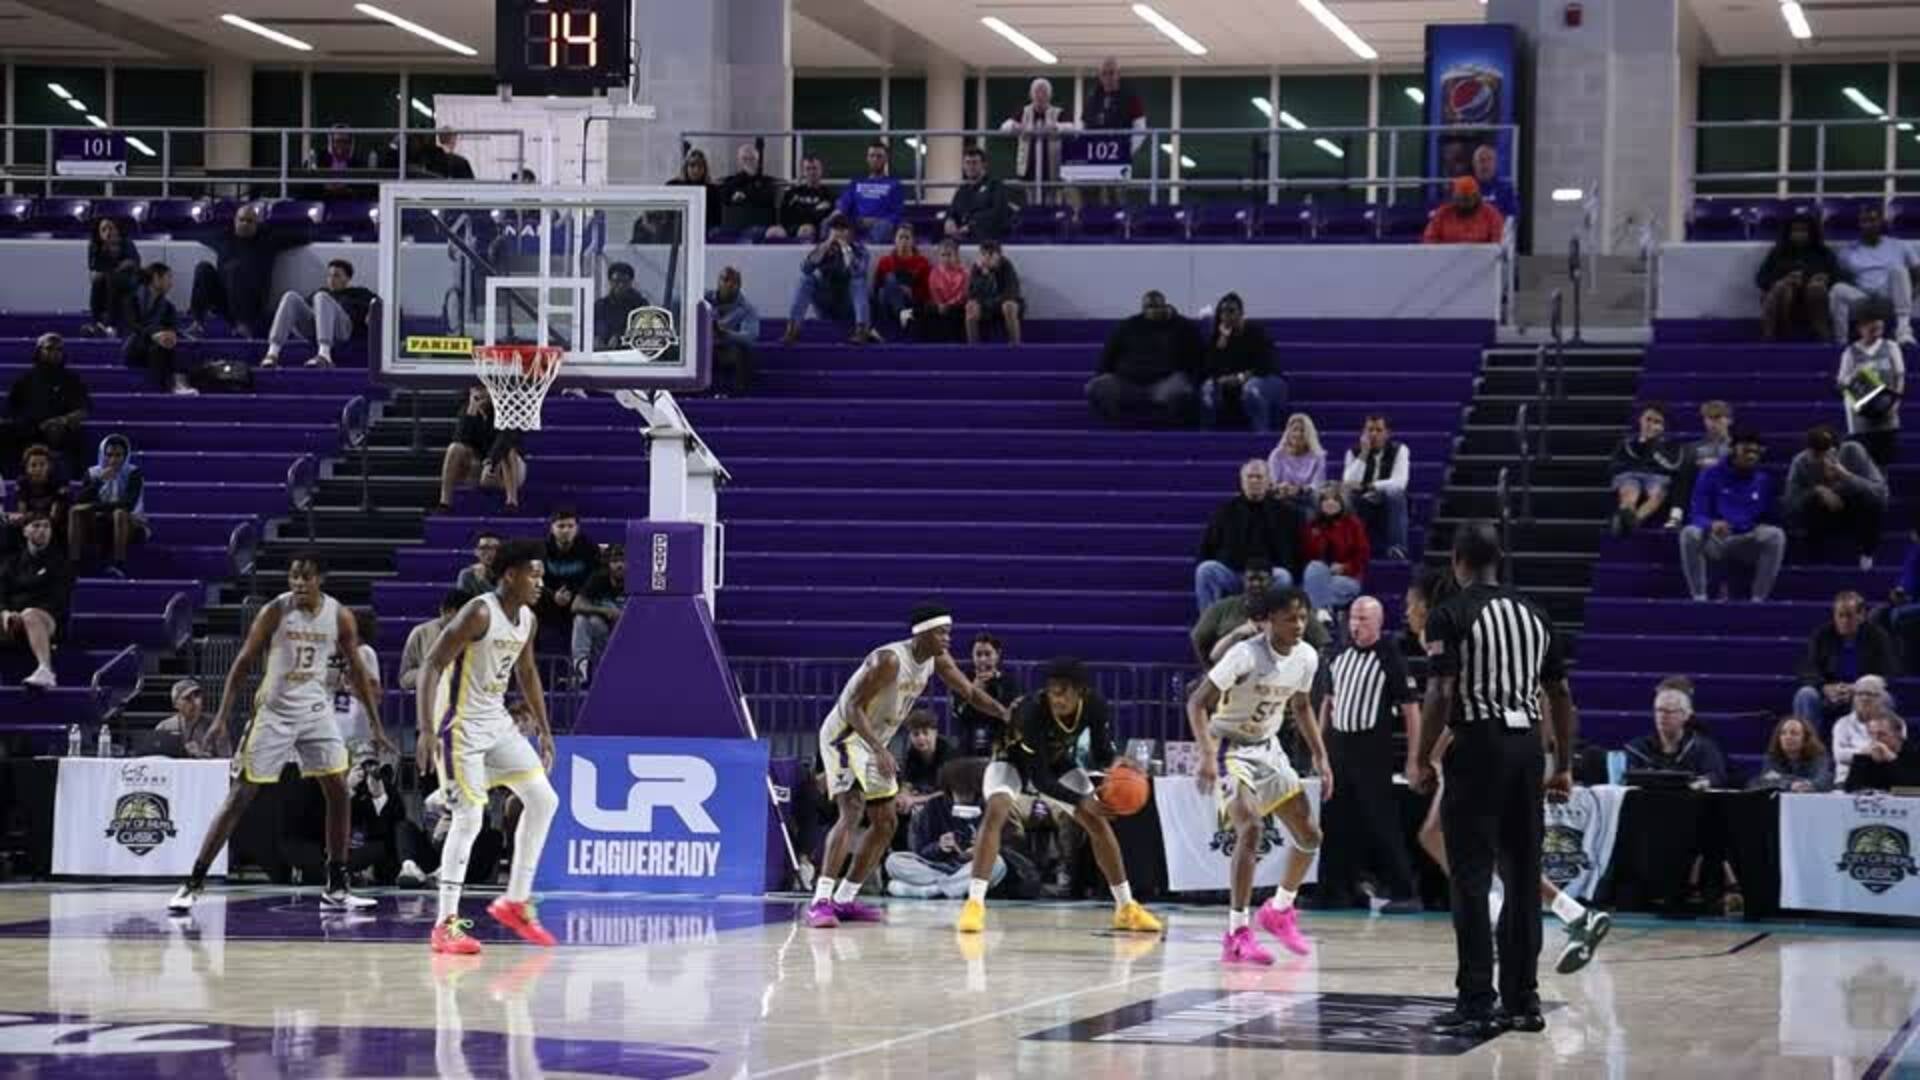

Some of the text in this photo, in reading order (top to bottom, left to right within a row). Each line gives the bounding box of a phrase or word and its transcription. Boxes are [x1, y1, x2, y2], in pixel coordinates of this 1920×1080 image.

[550, 12, 598, 67] 14
[84, 138, 112, 156] 101
[1087, 141, 1120, 160] 102
[409, 339, 469, 350] PANINI
[296, 646, 315, 669] 13
[568, 839, 721, 877] LEAGUEREADY
